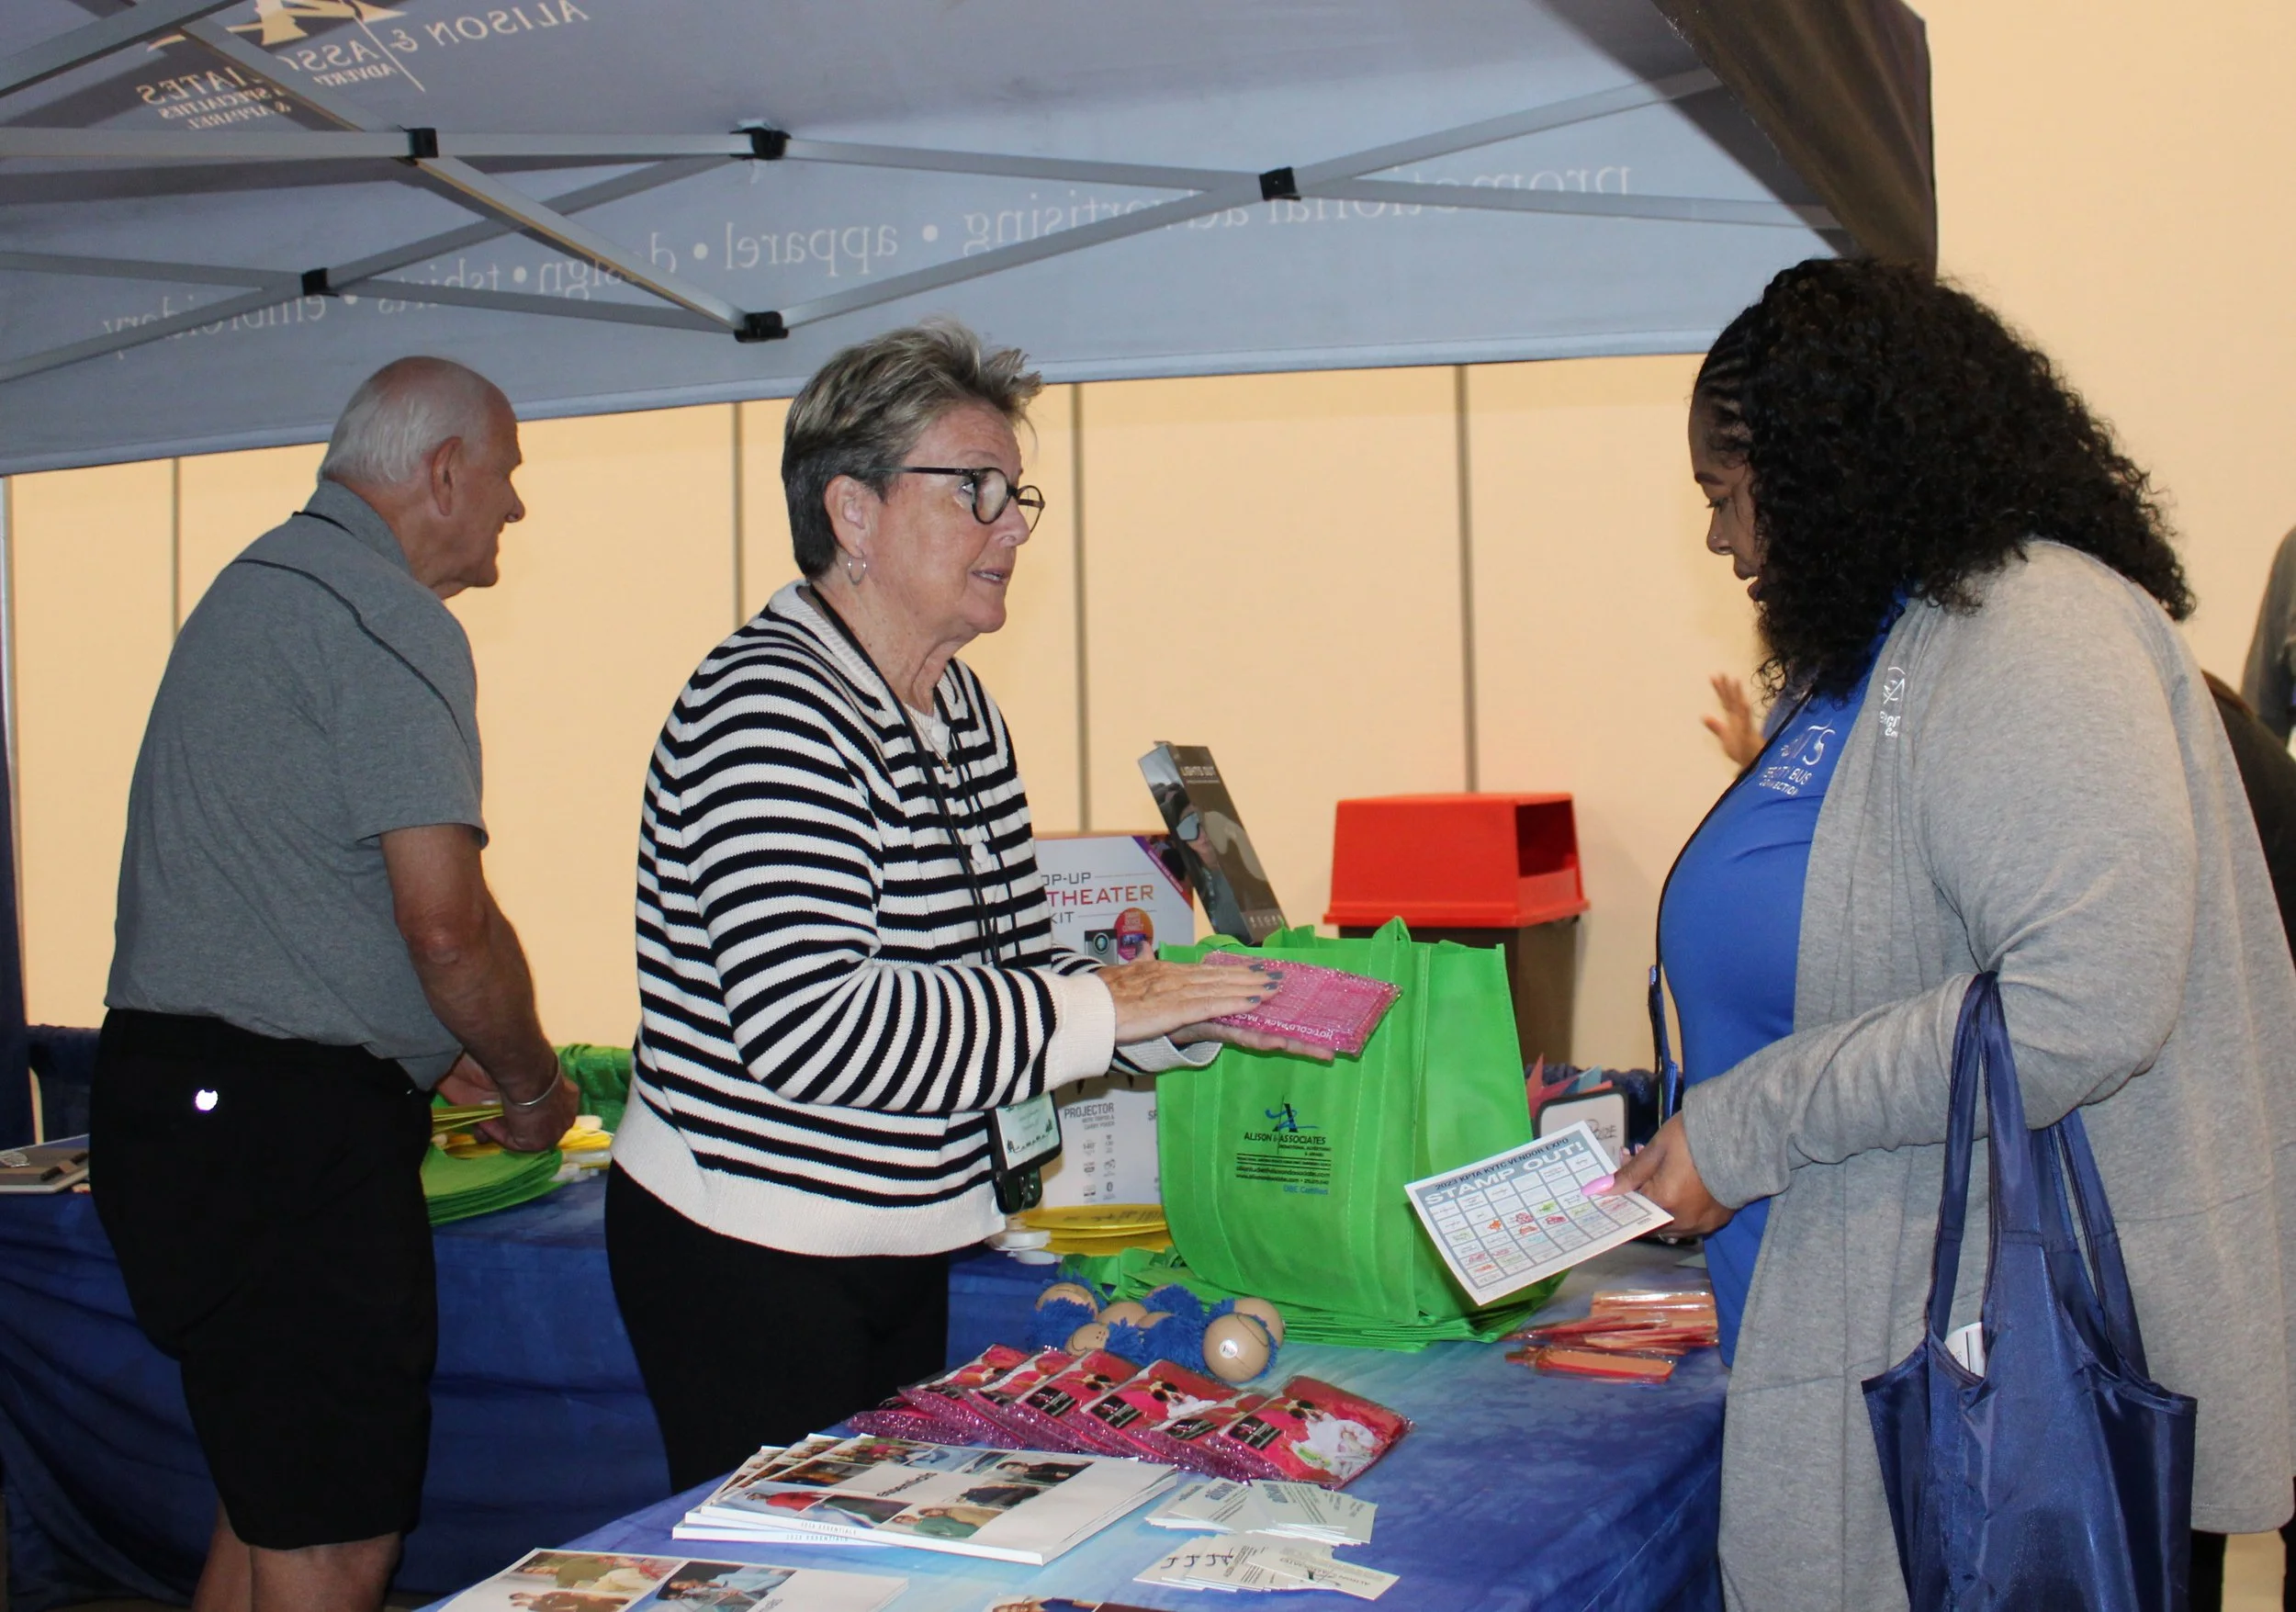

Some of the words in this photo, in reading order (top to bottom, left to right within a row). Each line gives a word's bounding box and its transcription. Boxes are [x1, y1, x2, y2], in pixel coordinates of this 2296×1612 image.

[1789, 768, 1813, 785] BUS
[1759, 778, 1800, 795] ECTION
[1041, 872, 1091, 886] OP-UP
[1047, 885, 1154, 907] THEATER
[1064, 1102, 1115, 1120] PROJECTOR
[1244, 1132, 1272, 1144] ALISON
[1278, 1133, 1327, 1145] ASSOCIATES
[1508, 1148, 1544, 1167] VENDOR
[1545, 1137, 1570, 1152] EXPO
[1424, 1168, 1515, 1205] STAMP
[1524, 1141, 1585, 1171] OUT!
